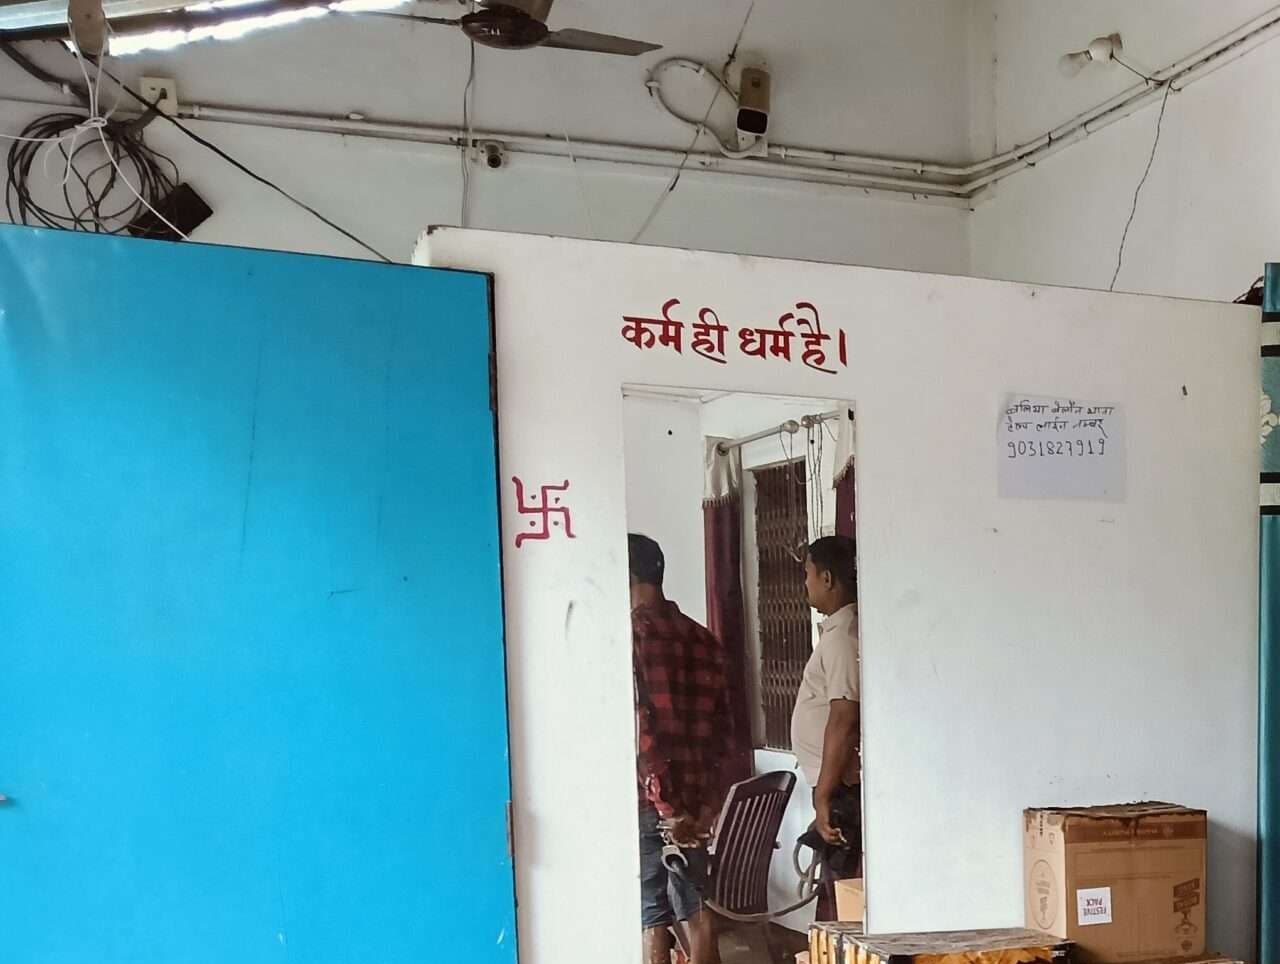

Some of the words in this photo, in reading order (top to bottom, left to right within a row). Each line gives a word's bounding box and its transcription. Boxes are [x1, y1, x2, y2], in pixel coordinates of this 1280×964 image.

[621, 298, 685, 354] कर्म
[691, 307, 729, 364] ही
[738, 312, 796, 362] धर्म
